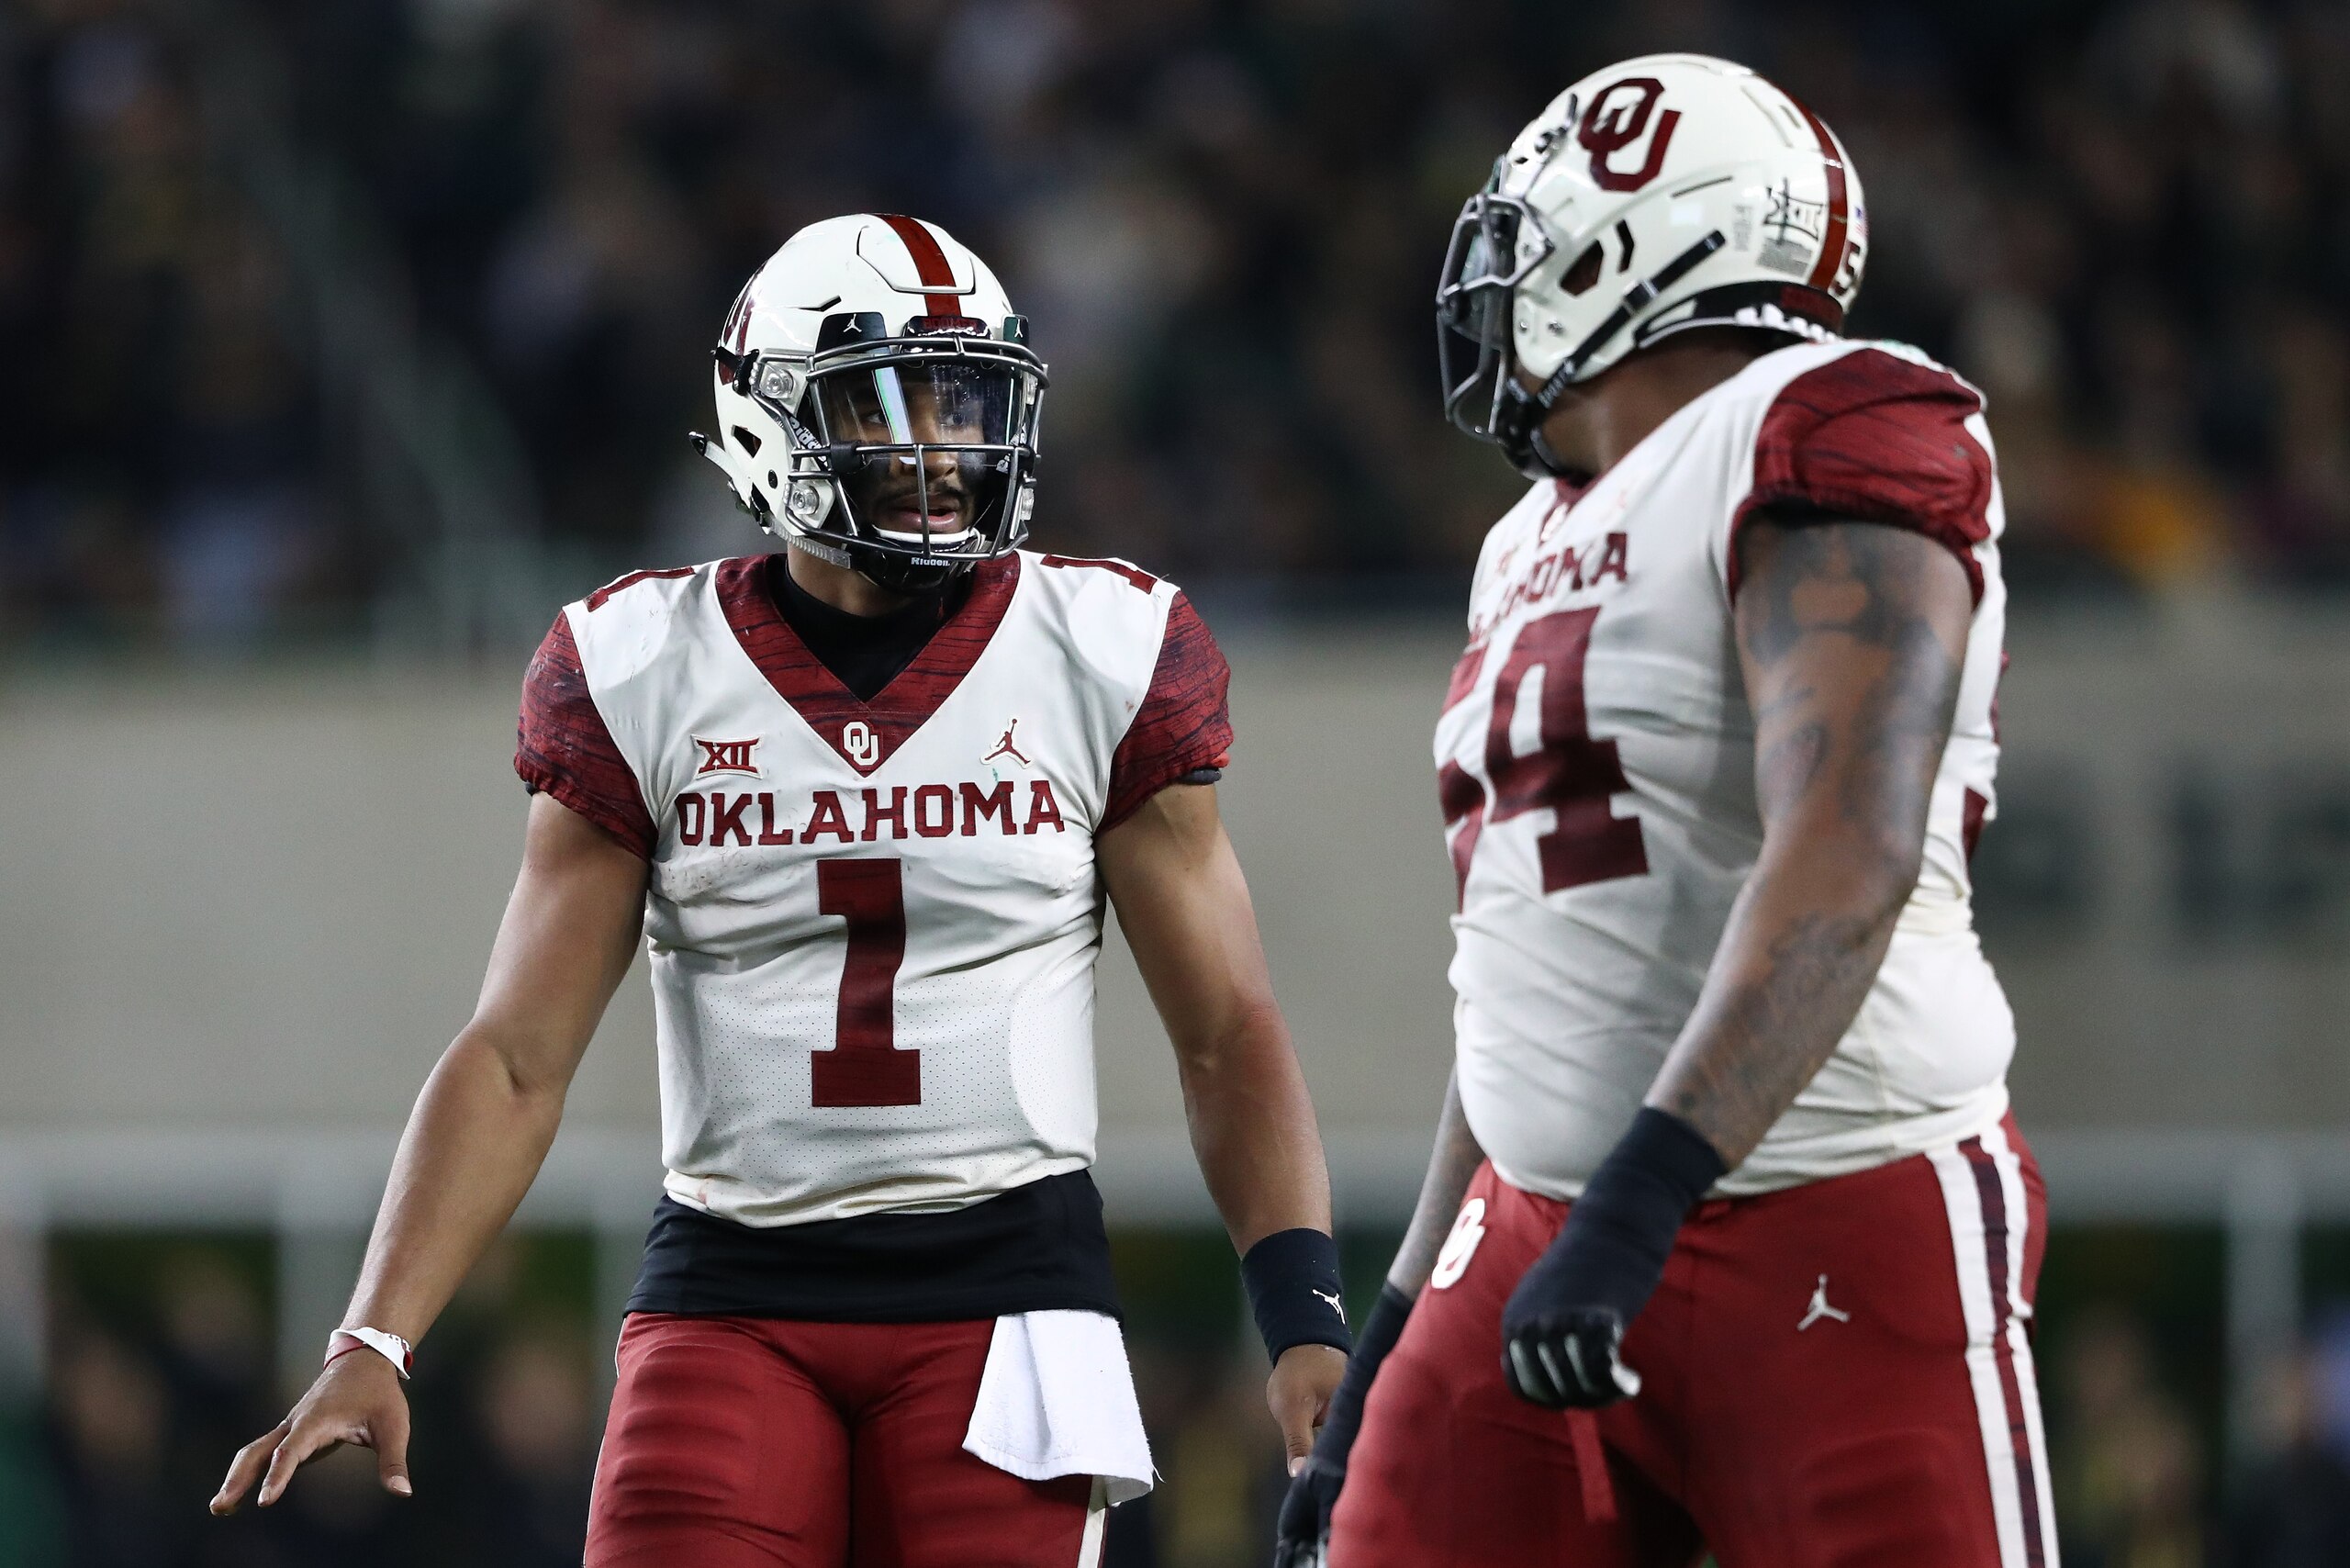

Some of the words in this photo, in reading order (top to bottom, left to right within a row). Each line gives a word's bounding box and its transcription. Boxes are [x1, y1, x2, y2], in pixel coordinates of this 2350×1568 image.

[1577, 78, 1681, 192] OU
[697, 738, 760, 774] XII
[843, 722, 878, 766] OU
[675, 780, 1065, 846] OKLAHOMA
[811, 858, 921, 1107] 1
